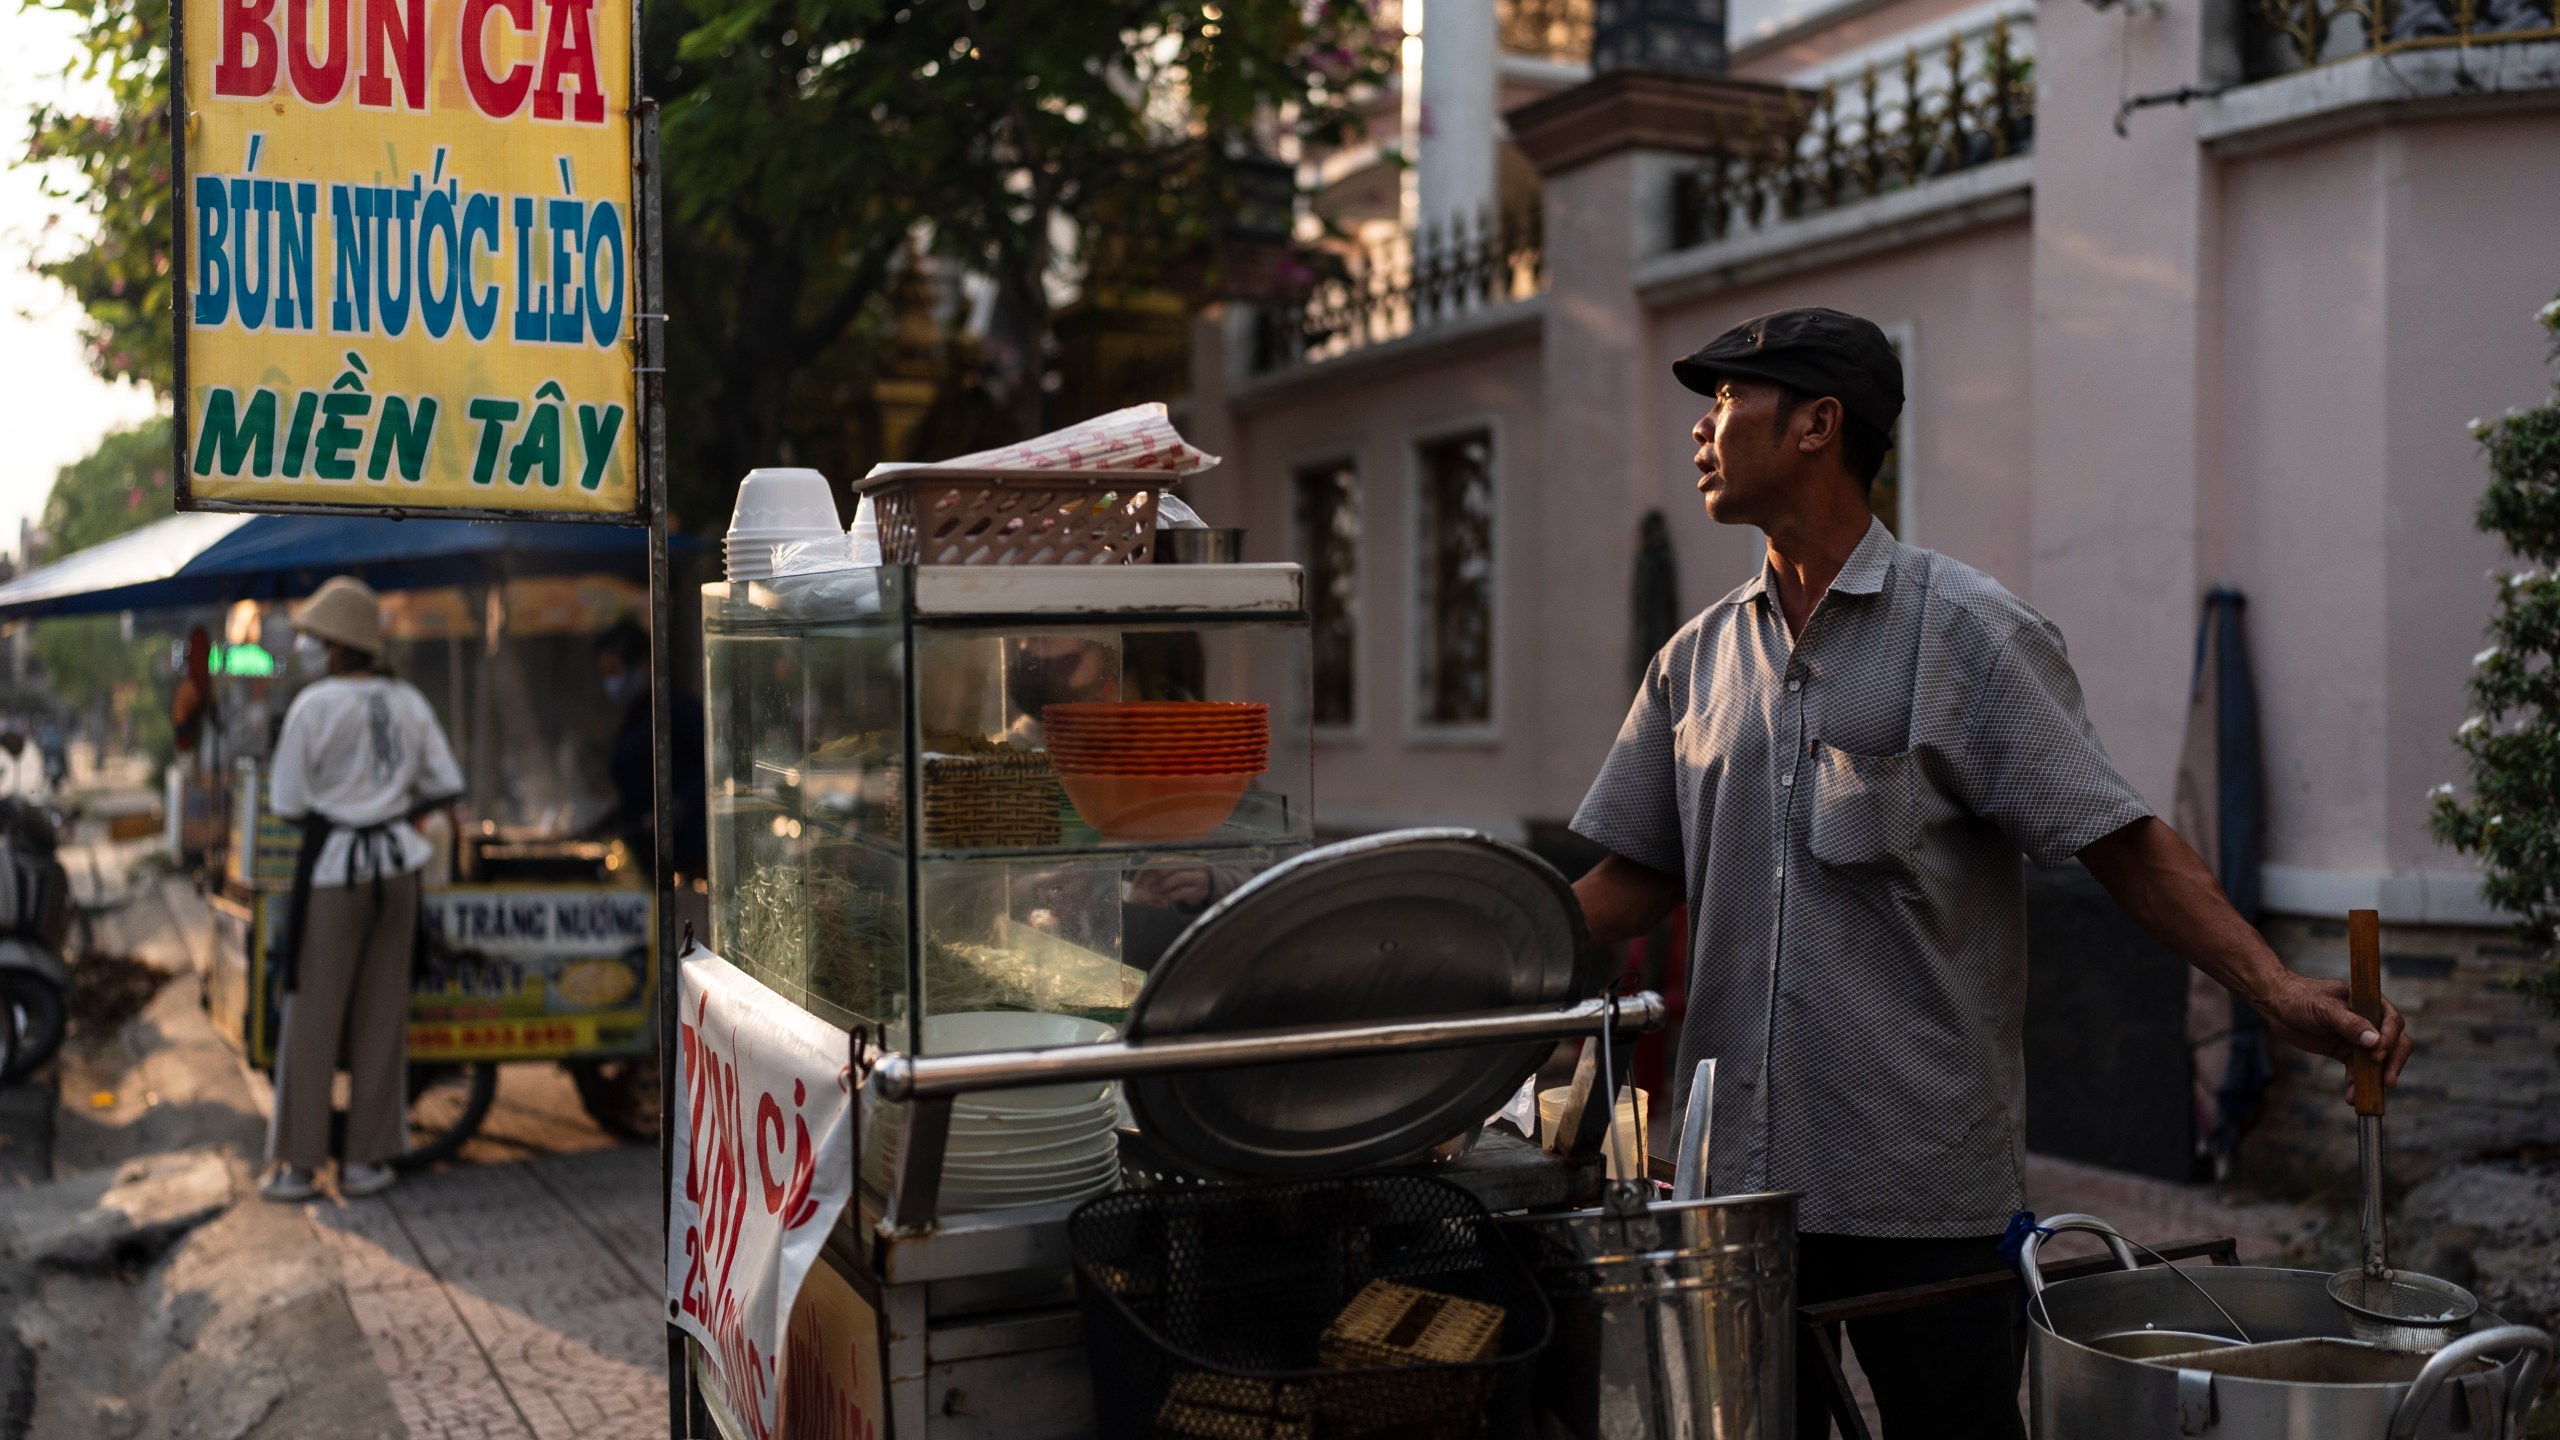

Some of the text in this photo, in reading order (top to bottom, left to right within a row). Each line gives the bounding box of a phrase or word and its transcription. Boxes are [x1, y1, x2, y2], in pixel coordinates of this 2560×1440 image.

[195, 134, 625, 347] BÚN NƯỚC LÈO
[193, 351, 624, 491] MIỀN TÂY
